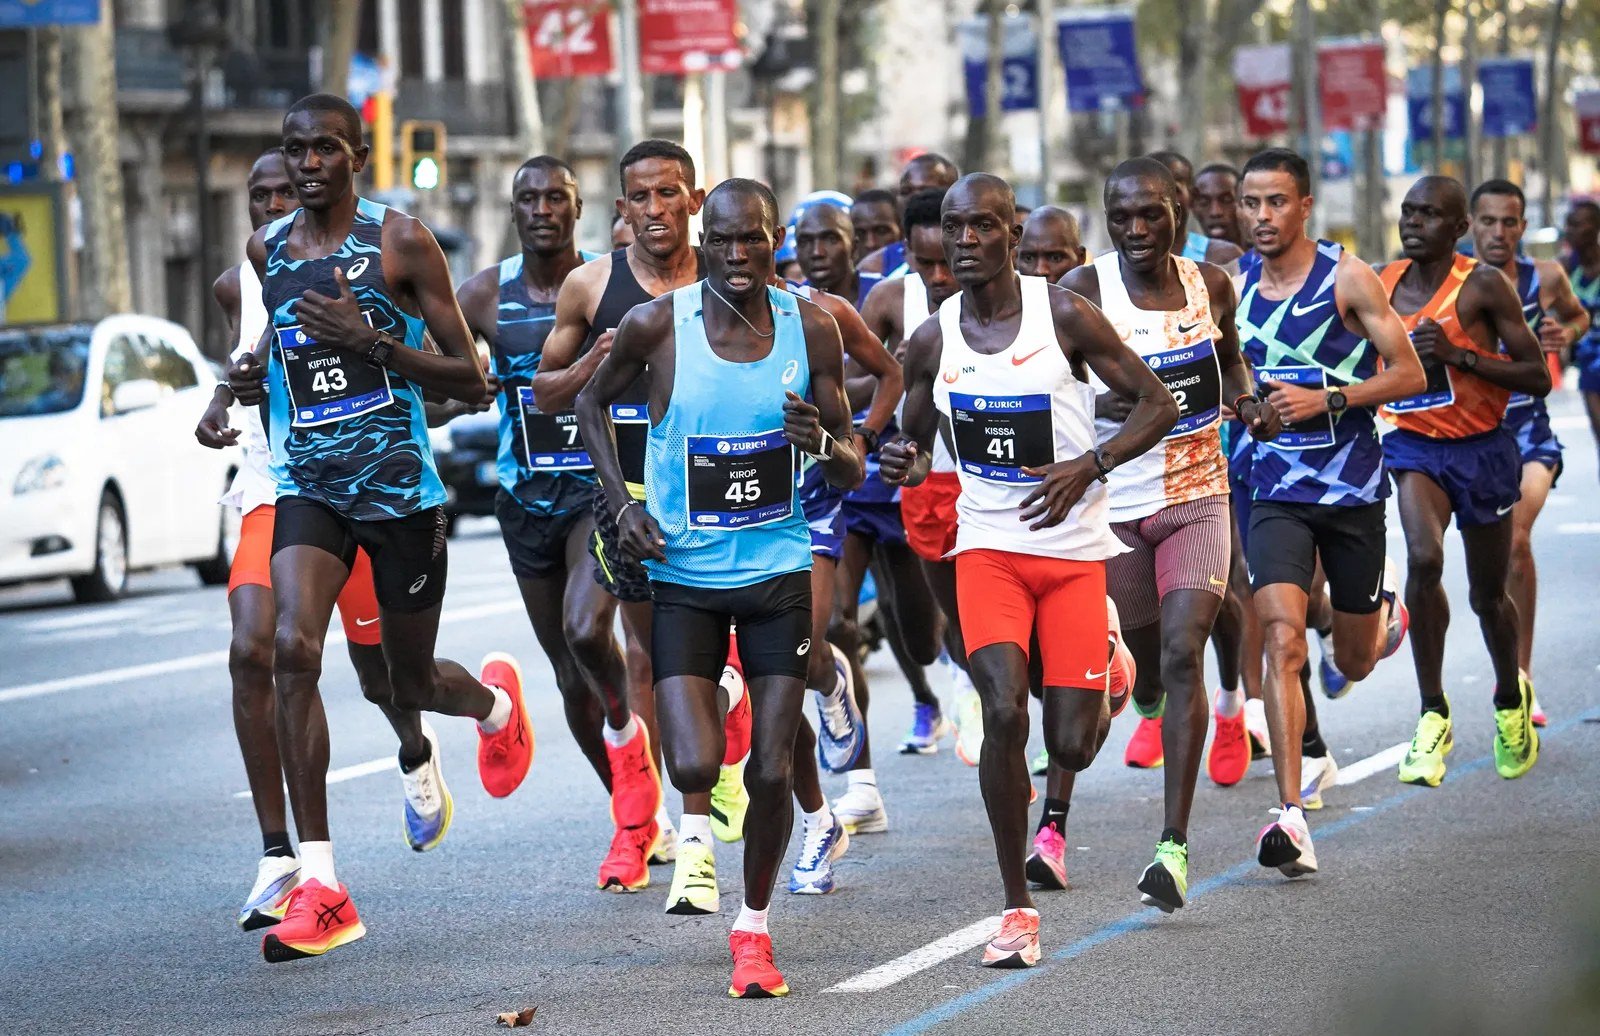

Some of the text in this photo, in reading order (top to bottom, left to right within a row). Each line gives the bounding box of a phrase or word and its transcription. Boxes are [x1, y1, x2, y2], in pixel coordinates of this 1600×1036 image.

[534, 9, 597, 55] 42
[307, 356, 341, 369] KIPTUM
[1162, 351, 1194, 364] ZURICH
[962, 365, 976, 374] NN
[312, 368, 348, 393] 43
[988, 400, 1022, 408] ZURICH
[555, 415, 578, 424] RUTT
[562, 425, 578, 445] 7
[984, 426, 1015, 436] KISSSA
[731, 440, 767, 451] ZURICH
[987, 438, 1015, 459] 41
[729, 469, 757, 479] KIROP
[724, 479, 761, 503] 45
